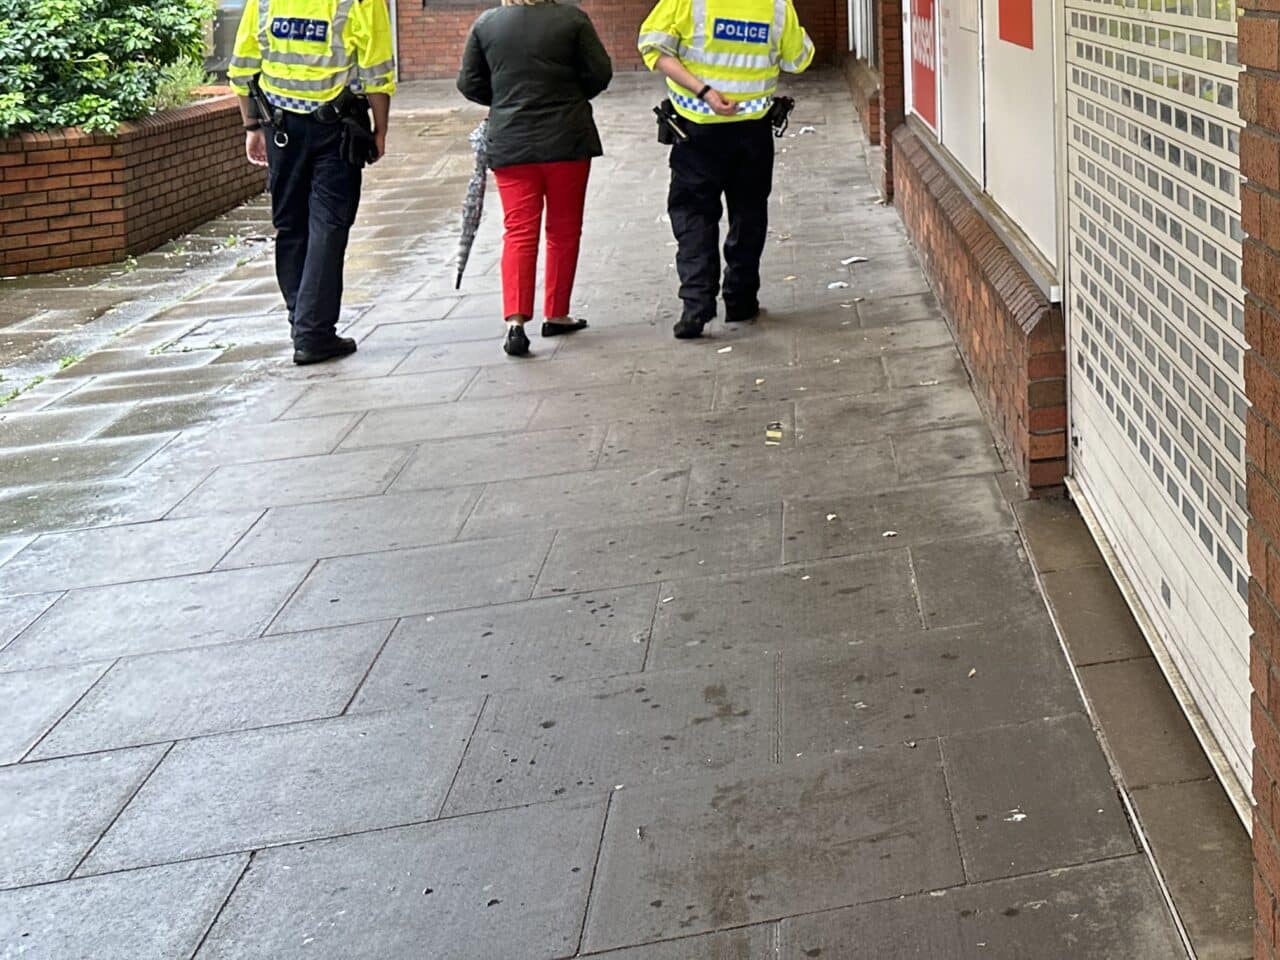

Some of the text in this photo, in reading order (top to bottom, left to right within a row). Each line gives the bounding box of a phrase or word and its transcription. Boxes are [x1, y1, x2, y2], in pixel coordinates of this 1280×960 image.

[272, 20, 326, 38] POLICE
[715, 23, 767, 39] POLICE
[911, 0, 935, 72] closed
